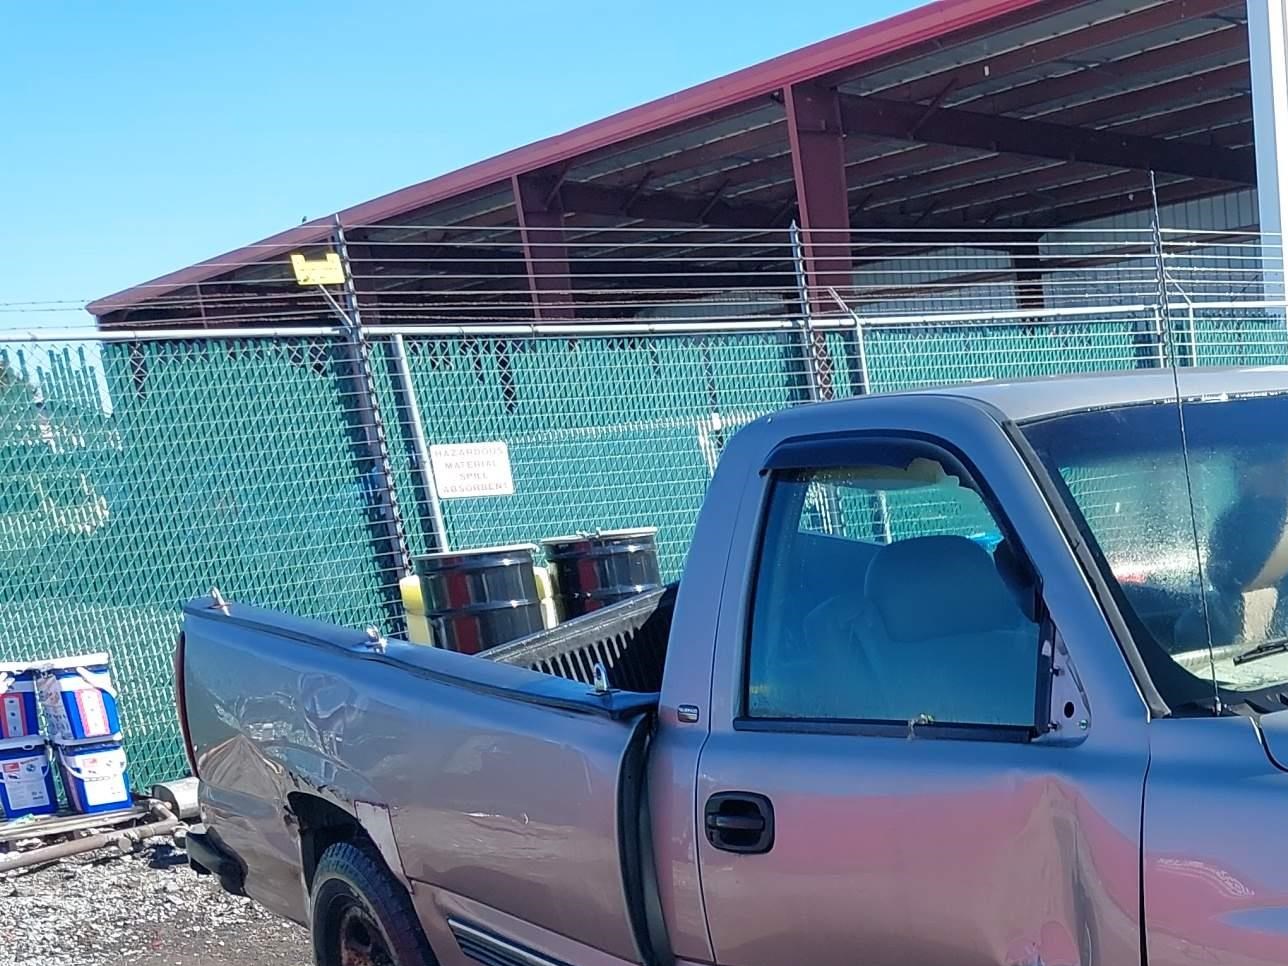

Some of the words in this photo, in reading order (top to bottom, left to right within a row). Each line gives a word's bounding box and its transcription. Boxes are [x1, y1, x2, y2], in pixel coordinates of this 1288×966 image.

[434, 447, 504, 457] HAZARDOUS
[444, 460, 497, 470] MATERIAL
[459, 472, 488, 481] SPILL
[443, 482, 508, 493] ABSORBENT
